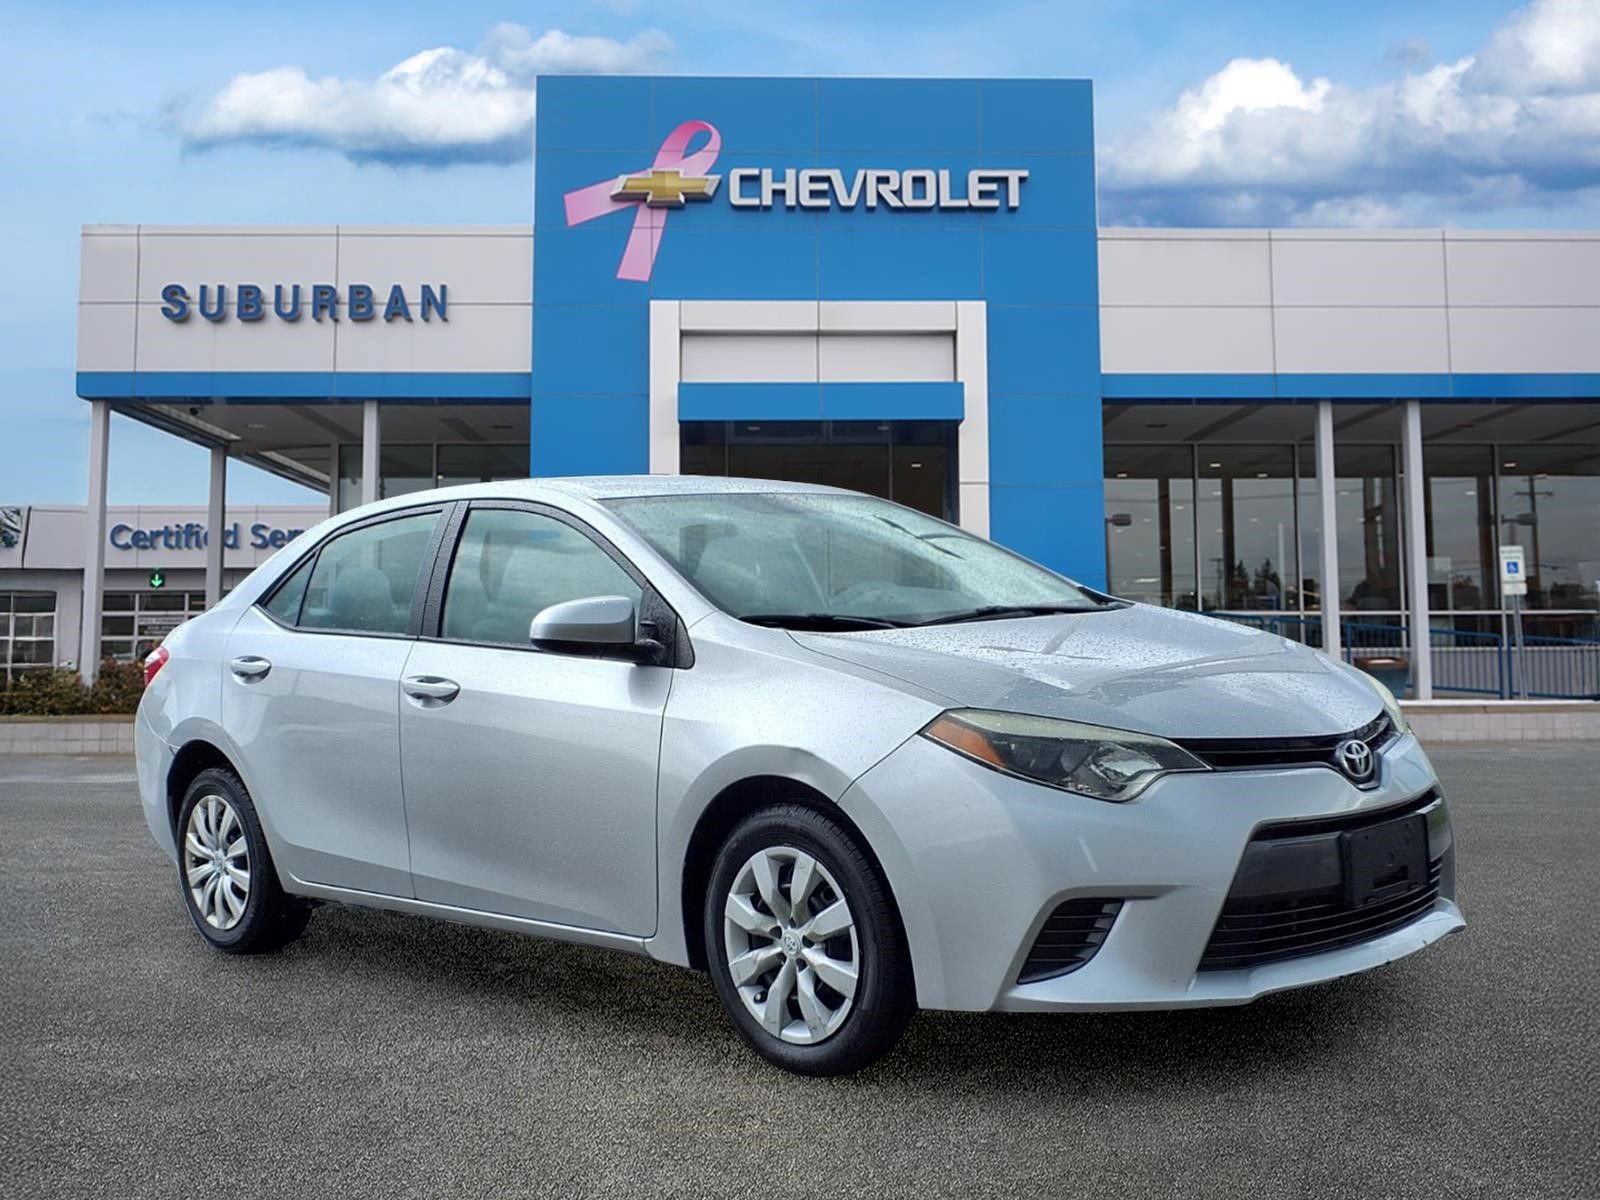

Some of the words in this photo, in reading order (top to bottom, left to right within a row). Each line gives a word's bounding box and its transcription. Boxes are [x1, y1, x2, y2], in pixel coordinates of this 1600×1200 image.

[729, 168, 1029, 208] CHEVROLET
[161, 284, 449, 322] SUBURBAN
[251, 523, 304, 550] Ser
